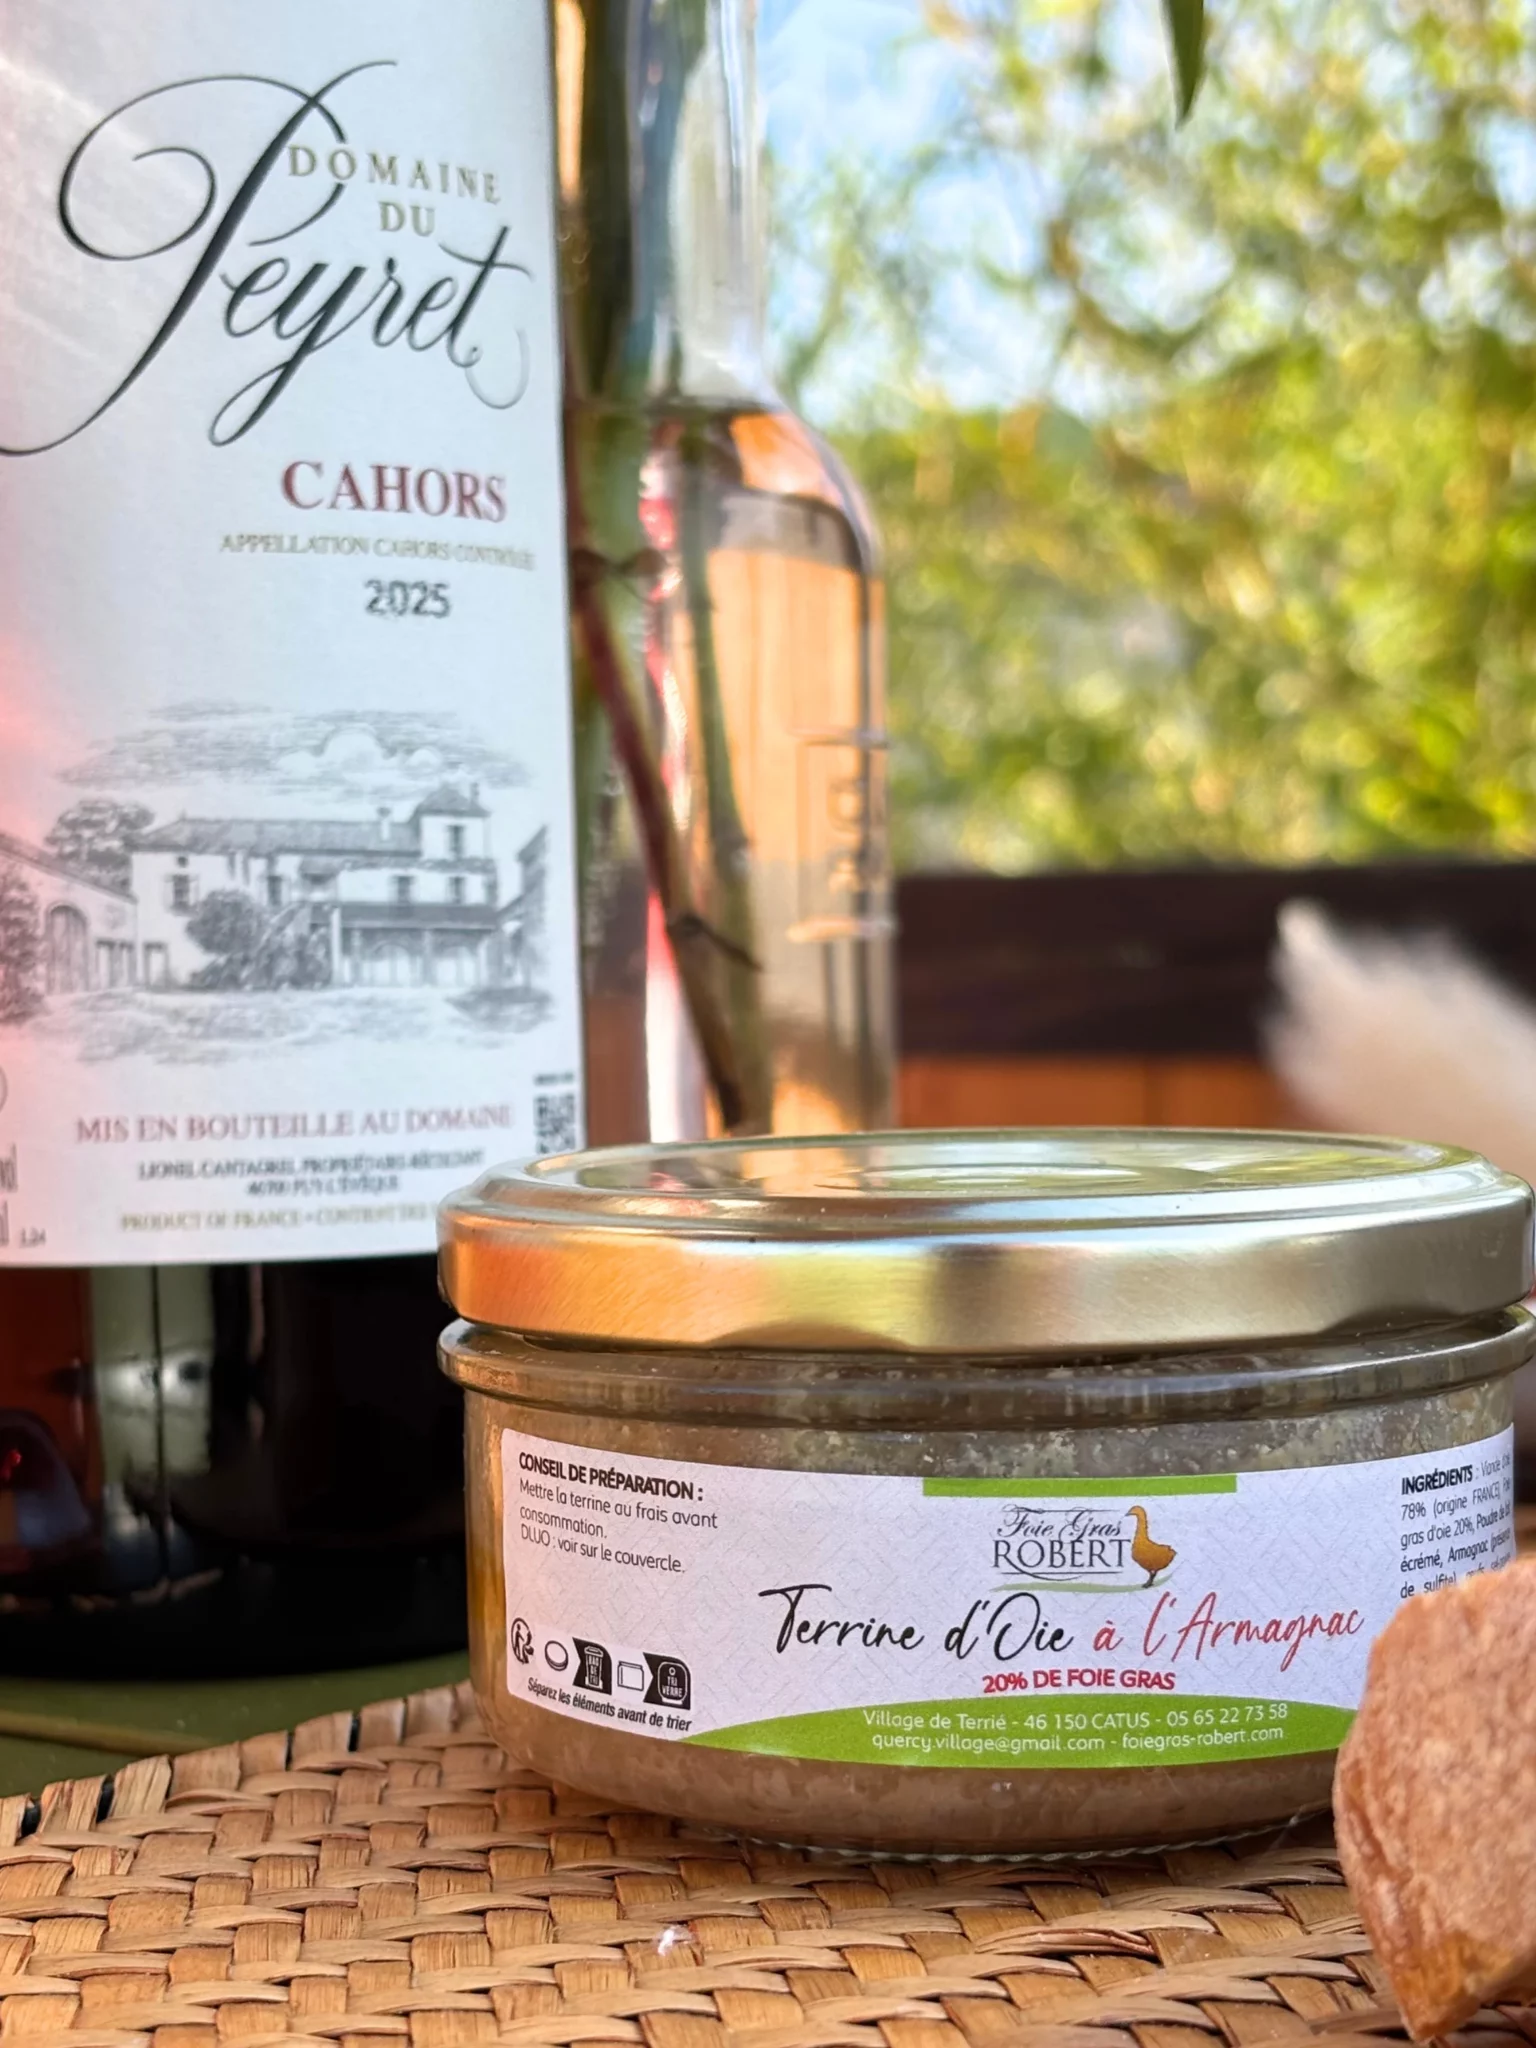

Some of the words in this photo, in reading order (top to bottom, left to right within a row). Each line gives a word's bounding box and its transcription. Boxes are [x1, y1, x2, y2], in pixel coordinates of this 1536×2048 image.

[288, 144, 502, 206] DOMAINE
[379, 201, 436, 238] DU
[0, 60, 532, 457] Peyret
[280, 460, 509, 524] CAHORS
[219, 533, 370, 556] APPELLATION
[373, 537, 452, 561] CAHORS
[364, 577, 453, 620] 2025
[76, 1115, 130, 1144] MIS
[137, 1113, 179, 1143] EN
[186, 1110, 352, 1142] BOUTEILLE
[360, 1107, 400, 1136] AU
[405, 1103, 514, 1134] DOMAINE
[519, 1451, 567, 1480] CONSEIL
[568, 1463, 587, 1485] DE
[589, 1467, 694, 1501] PRÉPARATION
[1401, 1464, 1473, 1496] INGRÉDIENTS
[519, 1477, 555, 1502] Mettre
[556, 1485, 568, 1505] la
[569, 1492, 612, 1515] terrine
[614, 1502, 632, 1518] au
[636, 1501, 669, 1523] frais
[672, 1510, 719, 1530] avant
[1401, 1501, 1427, 1522] 78%
[1433, 1495, 1468, 1519] (origine
[519, 1505, 608, 1540] consommation.
[996, 1503, 1056, 1538] Foie
[1061, 1506, 1123, 1546] Gras
[1400, 1532, 1425, 1551] gras
[1426, 1523, 1451, 1542] d'oie
[521, 1523, 551, 1547] DLUO
[558, 1537, 579, 1554] voir
[580, 1543, 599, 1559] sur
[600, 1542, 612, 1562] le
[614, 1549, 686, 1575] couvercle.
[993, 1539, 1131, 1570] ROBERT
[1400, 1548, 1444, 1573] écrémé,
[1447, 1538, 1489, 1564] Armagnac
[1400, 1580, 1415, 1599] de
[757, 1583, 926, 1654] Terrine
[943, 1591, 1075, 1662] d'Oie
[1092, 1620, 1125, 1652] à
[1142, 1590, 1365, 1673] l'Armagnac
[661, 1685, 684, 1699] VERRE
[981, 1672, 1028, 1694] 20%
[1032, 1669, 1063, 1690] DE
[1066, 1667, 1115, 1688] FOIE
[1118, 1668, 1177, 1691] GRAS
[527, 1676, 557, 1702] Séparez
[558, 1687, 571, 1706] les
[572, 1691, 616, 1718] éléments
[617, 1706, 647, 1725] avant
[649, 1710, 664, 1728] de
[666, 1713, 693, 1732] trier
[862, 1708, 925, 1732] Village
[929, 1713, 951, 1729] de
[1023, 1713, 1048, 1730] 46
[1053, 1713, 1088, 1731] 150
[1091, 1711, 1151, 1731] CATUS
[1166, 1710, 1189, 1727] 05
[1193, 1708, 1215, 1726] 65
[1218, 1706, 1240, 1724] 22
[1244, 1705, 1264, 1722] 73
[1268, 1702, 1289, 1720] 58
[871, 1732, 1106, 1755] quercy.village@gmail.com
[1122, 1727, 1285, 1753] foiegras-robert.com
